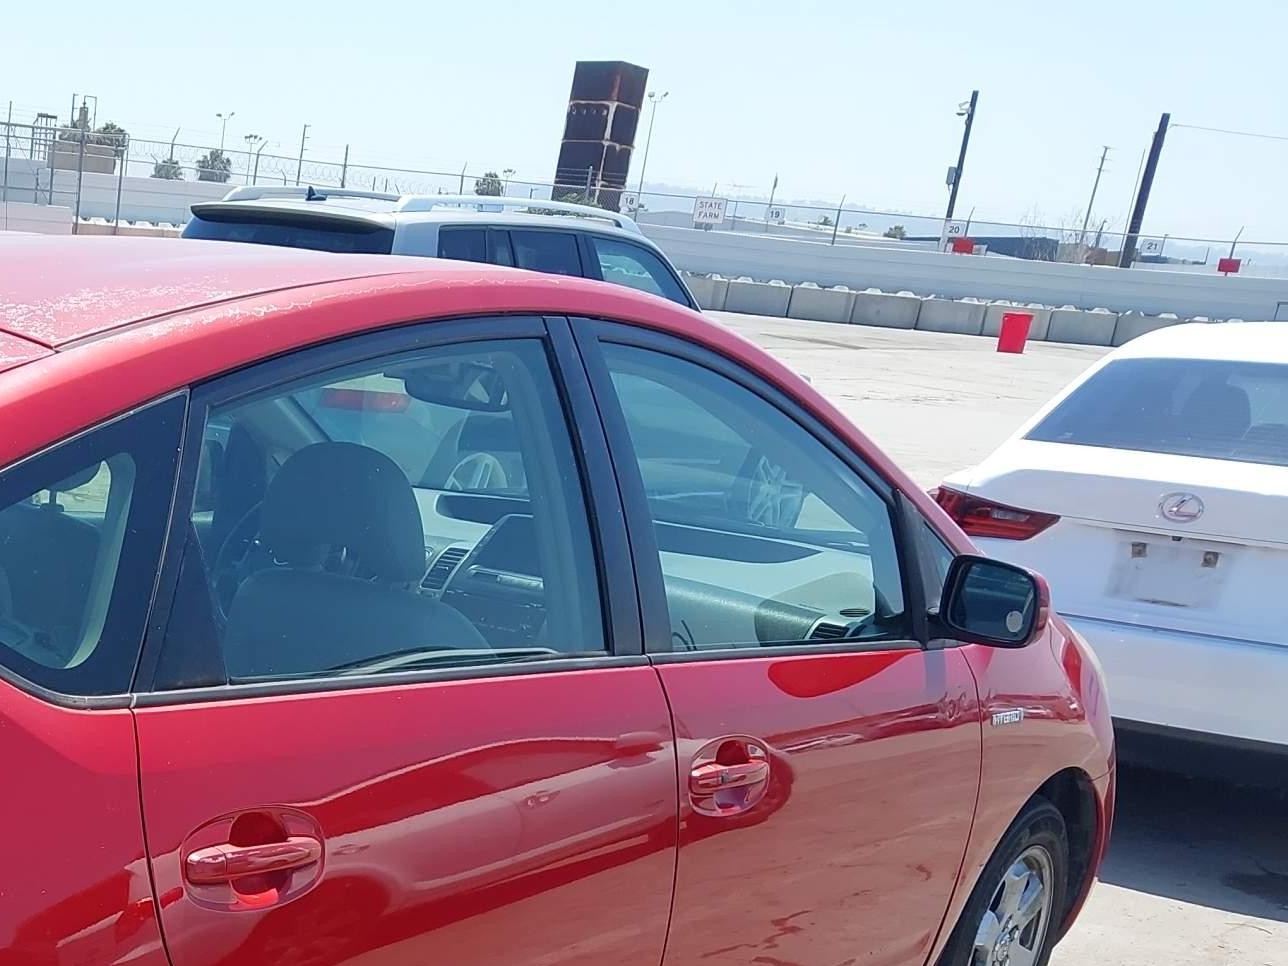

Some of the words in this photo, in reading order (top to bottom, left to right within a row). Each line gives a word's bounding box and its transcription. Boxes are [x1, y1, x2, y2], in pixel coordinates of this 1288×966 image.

[698, 200, 723, 211] STATE
[697, 210, 720, 220] FARM
[770, 210, 781, 219] 19
[948, 225, 960, 234] 20
[1146, 242, 1158, 251] 21
